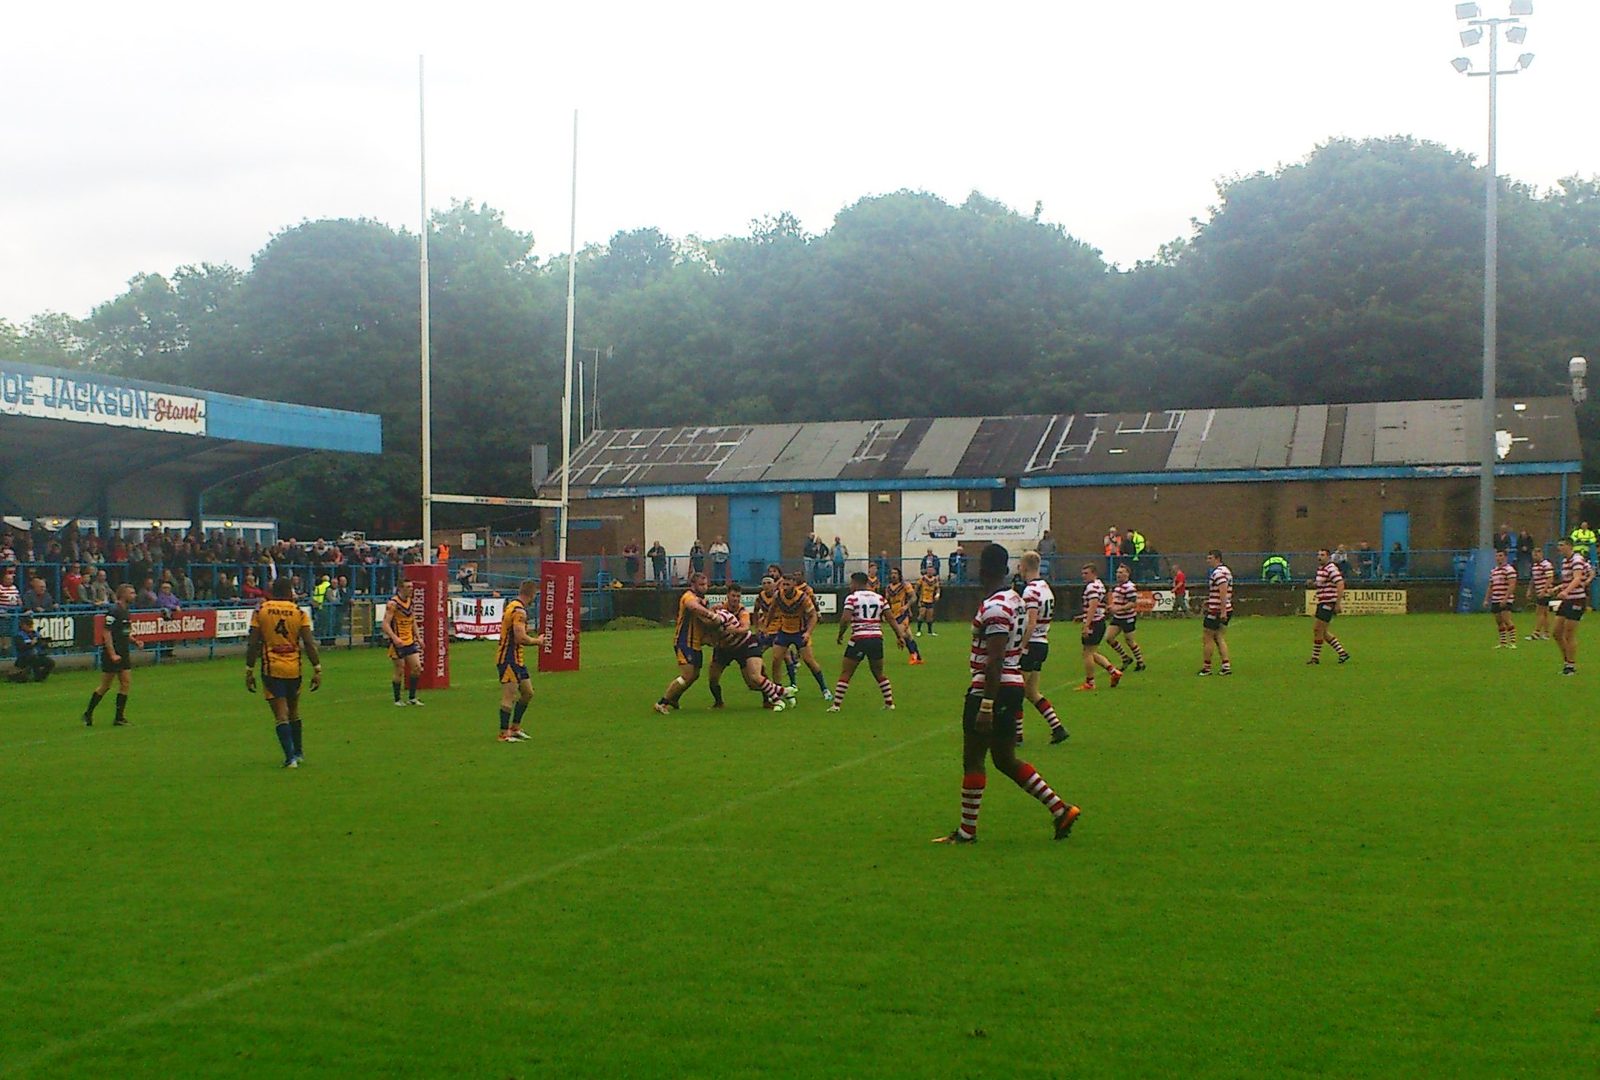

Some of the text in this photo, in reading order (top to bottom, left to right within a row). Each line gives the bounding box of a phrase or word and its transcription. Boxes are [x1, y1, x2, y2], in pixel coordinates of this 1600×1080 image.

[0, 373, 201, 424] OE JACKSON Stand
[545, 580, 556, 612] CIDER
[1354, 591, 1402, 601] LIMITED
[563, 576, 576, 661] Kingstone Press
[861, 604, 878, 619] 17
[32, 616, 75, 640] rama
[131, 619, 157, 635] stone
[157, 617, 181, 633] Press
[182, 615, 205, 631] Cider
[274, 618, 289, 639] 4
[437, 620, 446, 678] Kingstone
